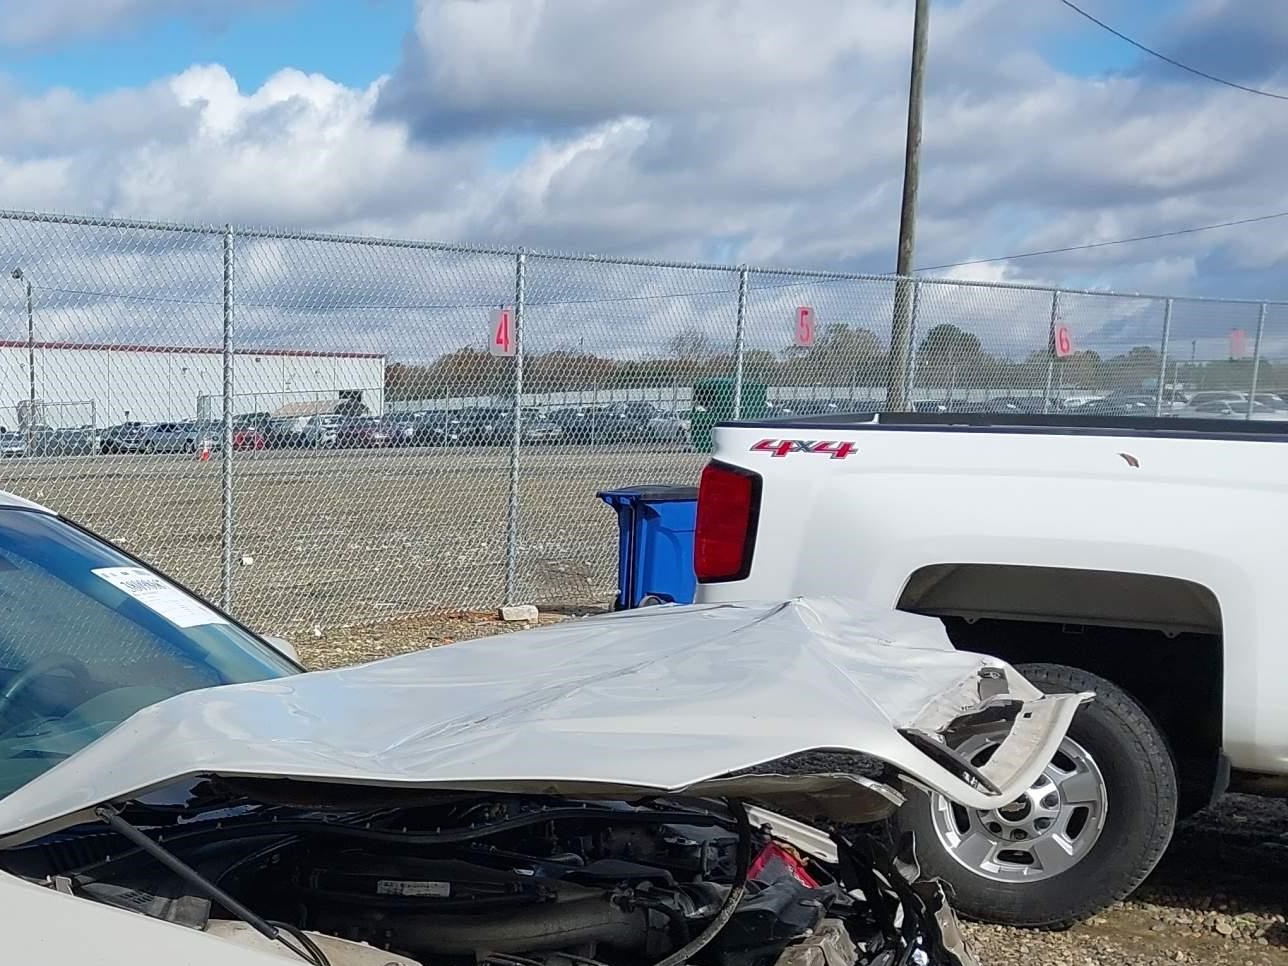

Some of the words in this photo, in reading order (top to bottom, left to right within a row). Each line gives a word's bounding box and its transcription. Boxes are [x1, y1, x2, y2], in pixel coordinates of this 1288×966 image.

[496, 313, 510, 353] 4
[800, 310, 810, 343] 5
[1059, 327, 1071, 354] 6
